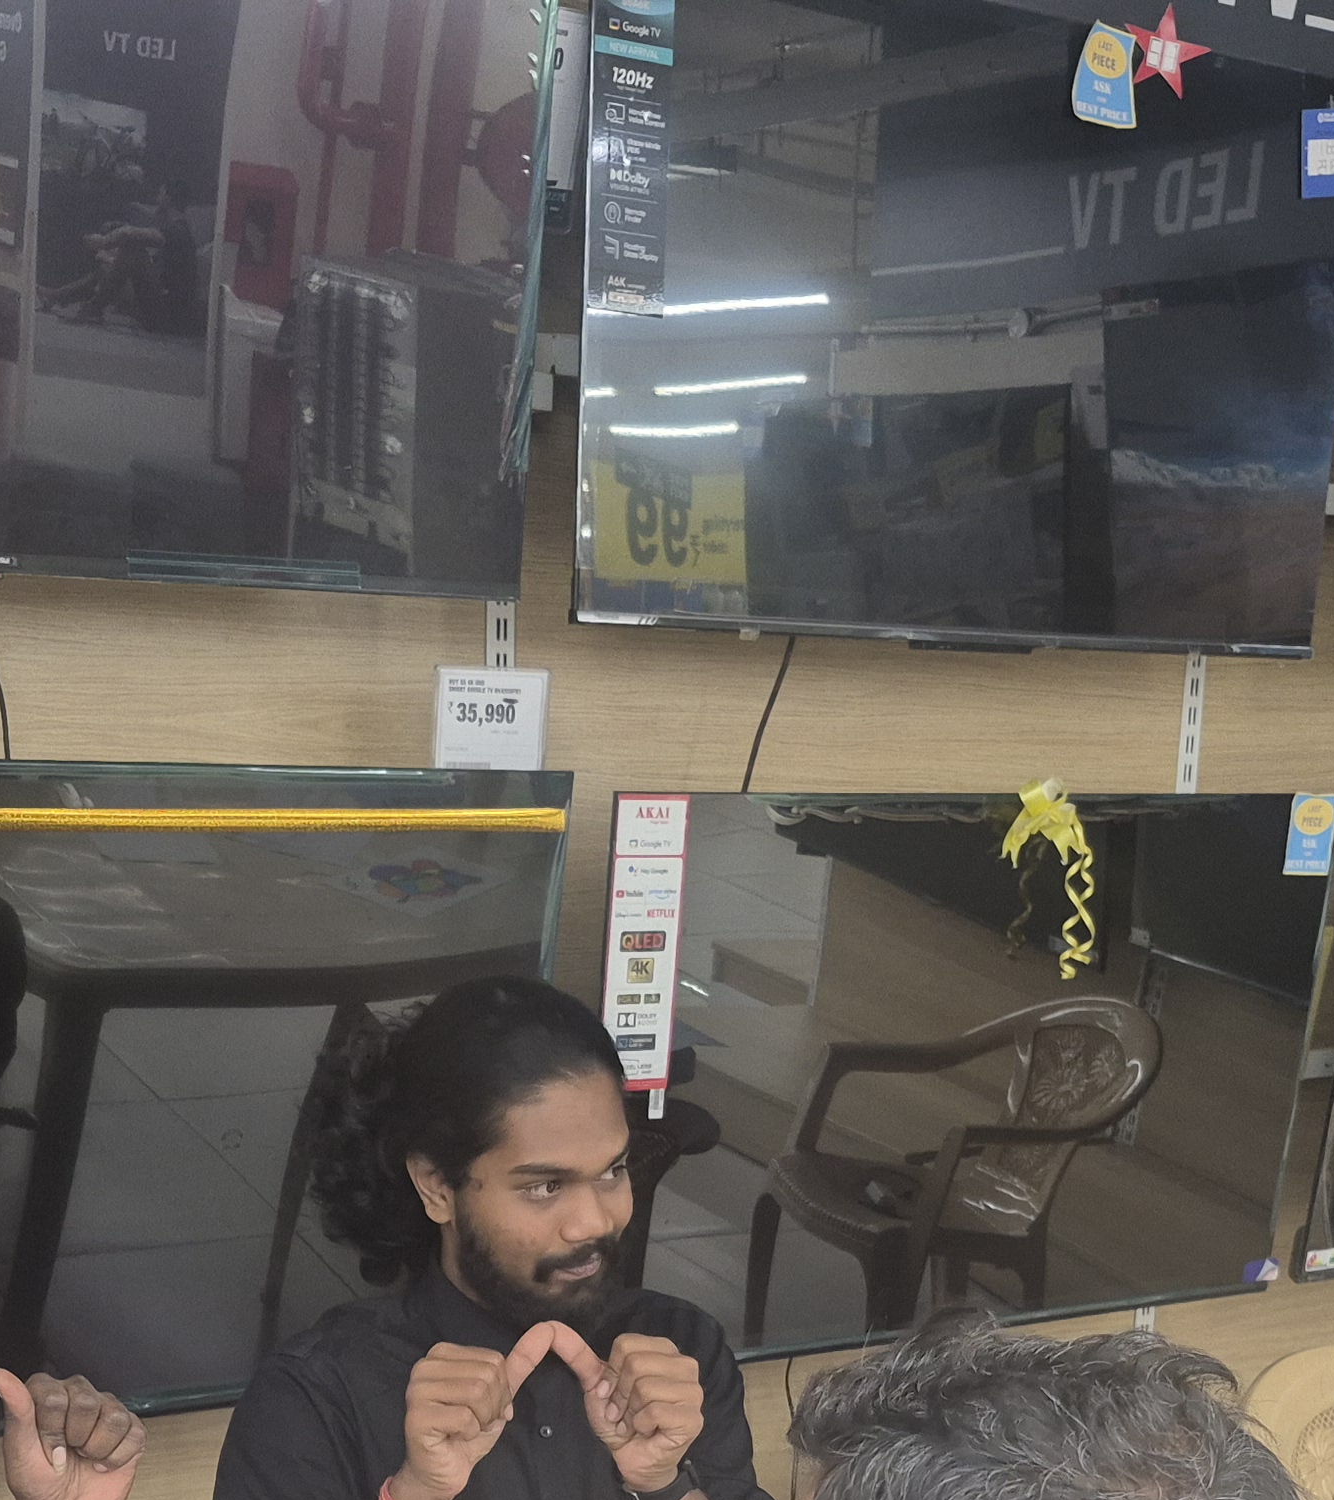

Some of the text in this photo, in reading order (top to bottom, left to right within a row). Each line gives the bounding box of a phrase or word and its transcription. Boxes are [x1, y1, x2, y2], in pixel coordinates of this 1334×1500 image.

[622, 21, 661, 38] Google TV
[1097, 39, 1113, 51] LAST
[1091, 52, 1116, 72] PIECE
[612, 66, 655, 89] 120Hz
[1093, 80, 1112, 95] ASK
[1076, 101, 1130, 122] BEST PRICE
[623, 171, 650, 188] Dolby
[635, 806, 670, 819] AKAI
[1302, 816, 1324, 828] PIECE
[640, 840, 662, 849] Google
[647, 909, 675, 918] NETFLIX
[622, 933, 665, 950] QLED
[631, 960, 650, 975] 4K
